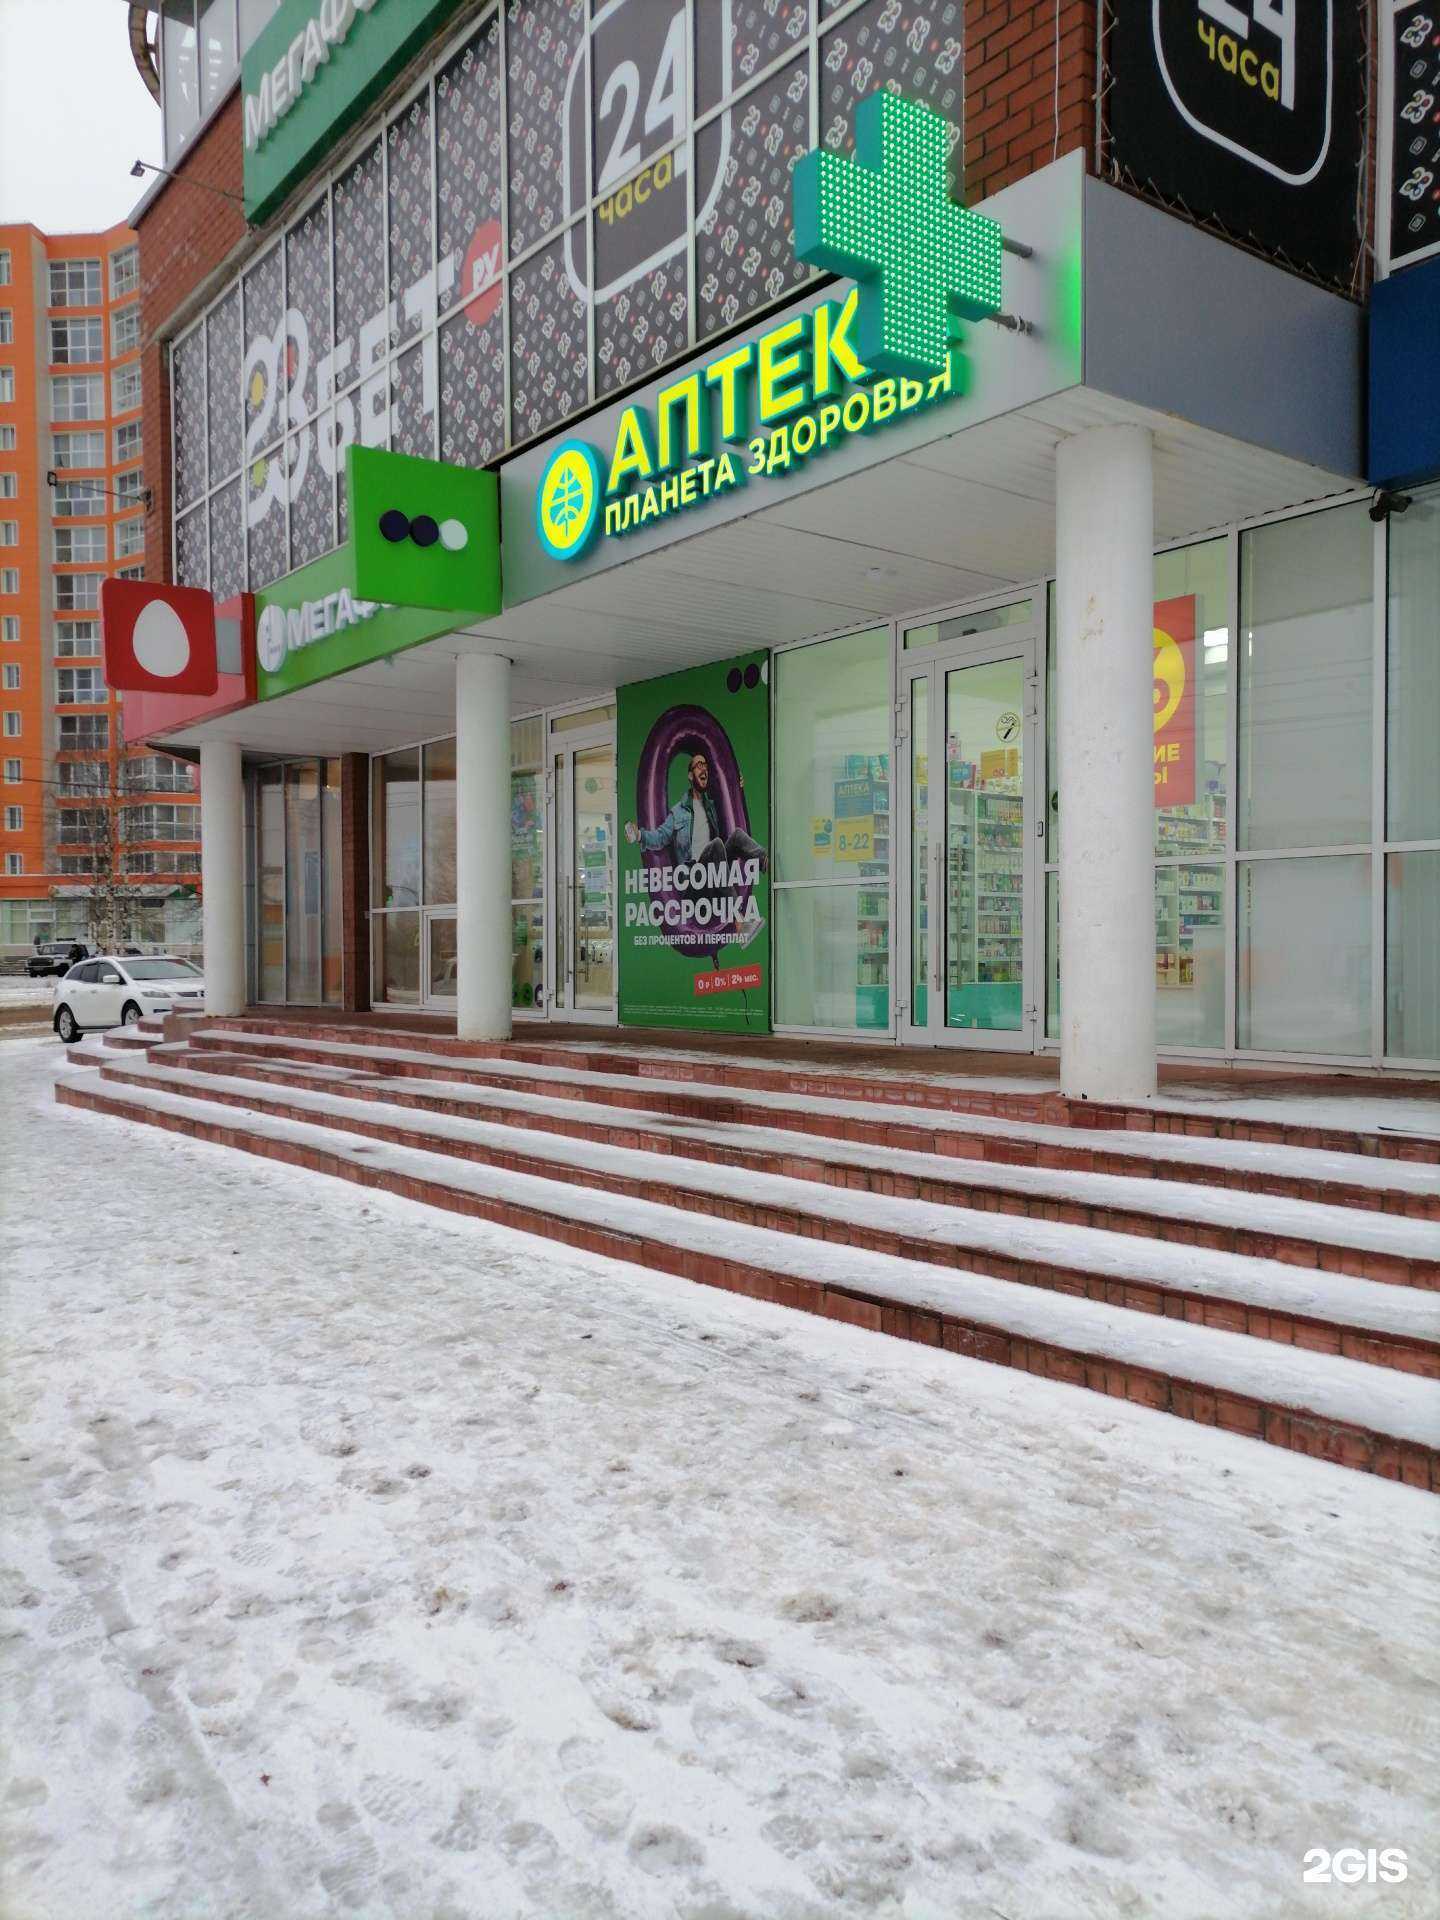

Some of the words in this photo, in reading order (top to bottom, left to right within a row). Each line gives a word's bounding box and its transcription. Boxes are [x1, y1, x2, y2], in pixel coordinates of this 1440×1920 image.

[244, 0, 378, 152] МЕГАФ
[1198, 18, 1281, 101] часа
[598, 7, 688, 192] 24
[598, 153, 673, 225] часа
[604, 453, 737, 536] ПЛАНЕТА
[625, 858, 760, 894] НЕВЕСОМАЯ
[625, 895, 762, 927] РАССРОЧКА
[634, 936, 648, 946] БЕЗ
[649, 934, 697, 946] ПРОЦЕНТОВ
[697, 933, 704, 945] И
